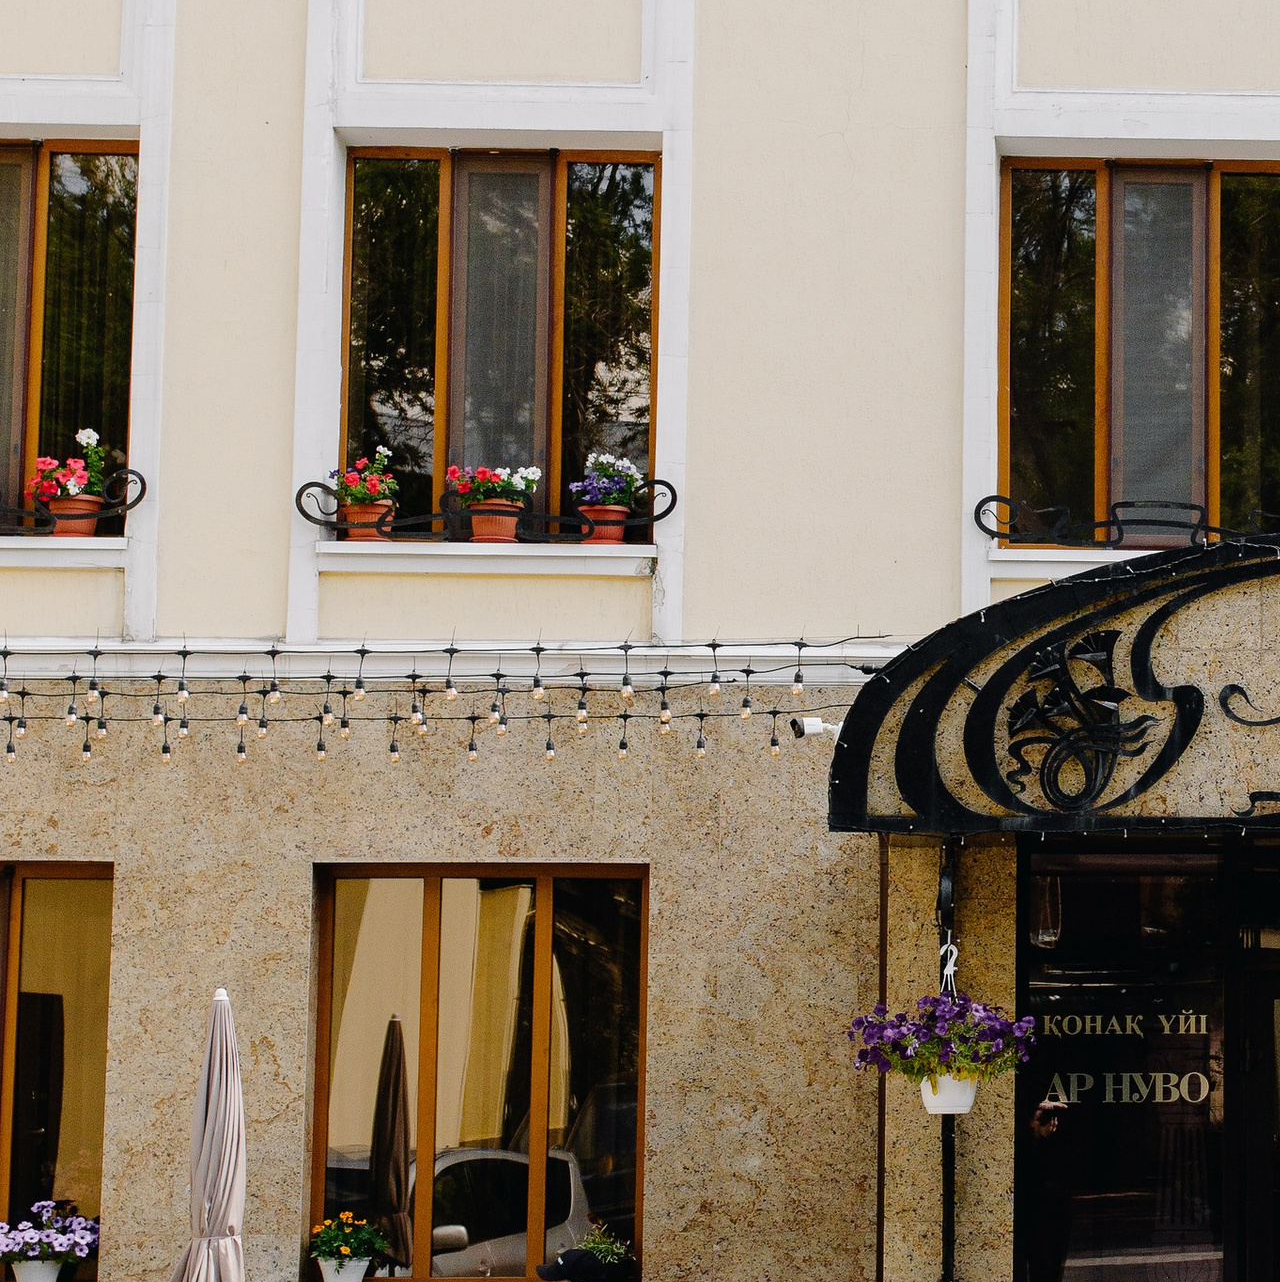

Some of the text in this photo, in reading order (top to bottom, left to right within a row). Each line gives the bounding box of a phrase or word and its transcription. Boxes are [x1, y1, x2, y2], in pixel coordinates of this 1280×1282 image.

[1043, 1014, 1144, 1039] ҚОНАҚ
[1044, 1072, 1209, 1103] АР НУВО
